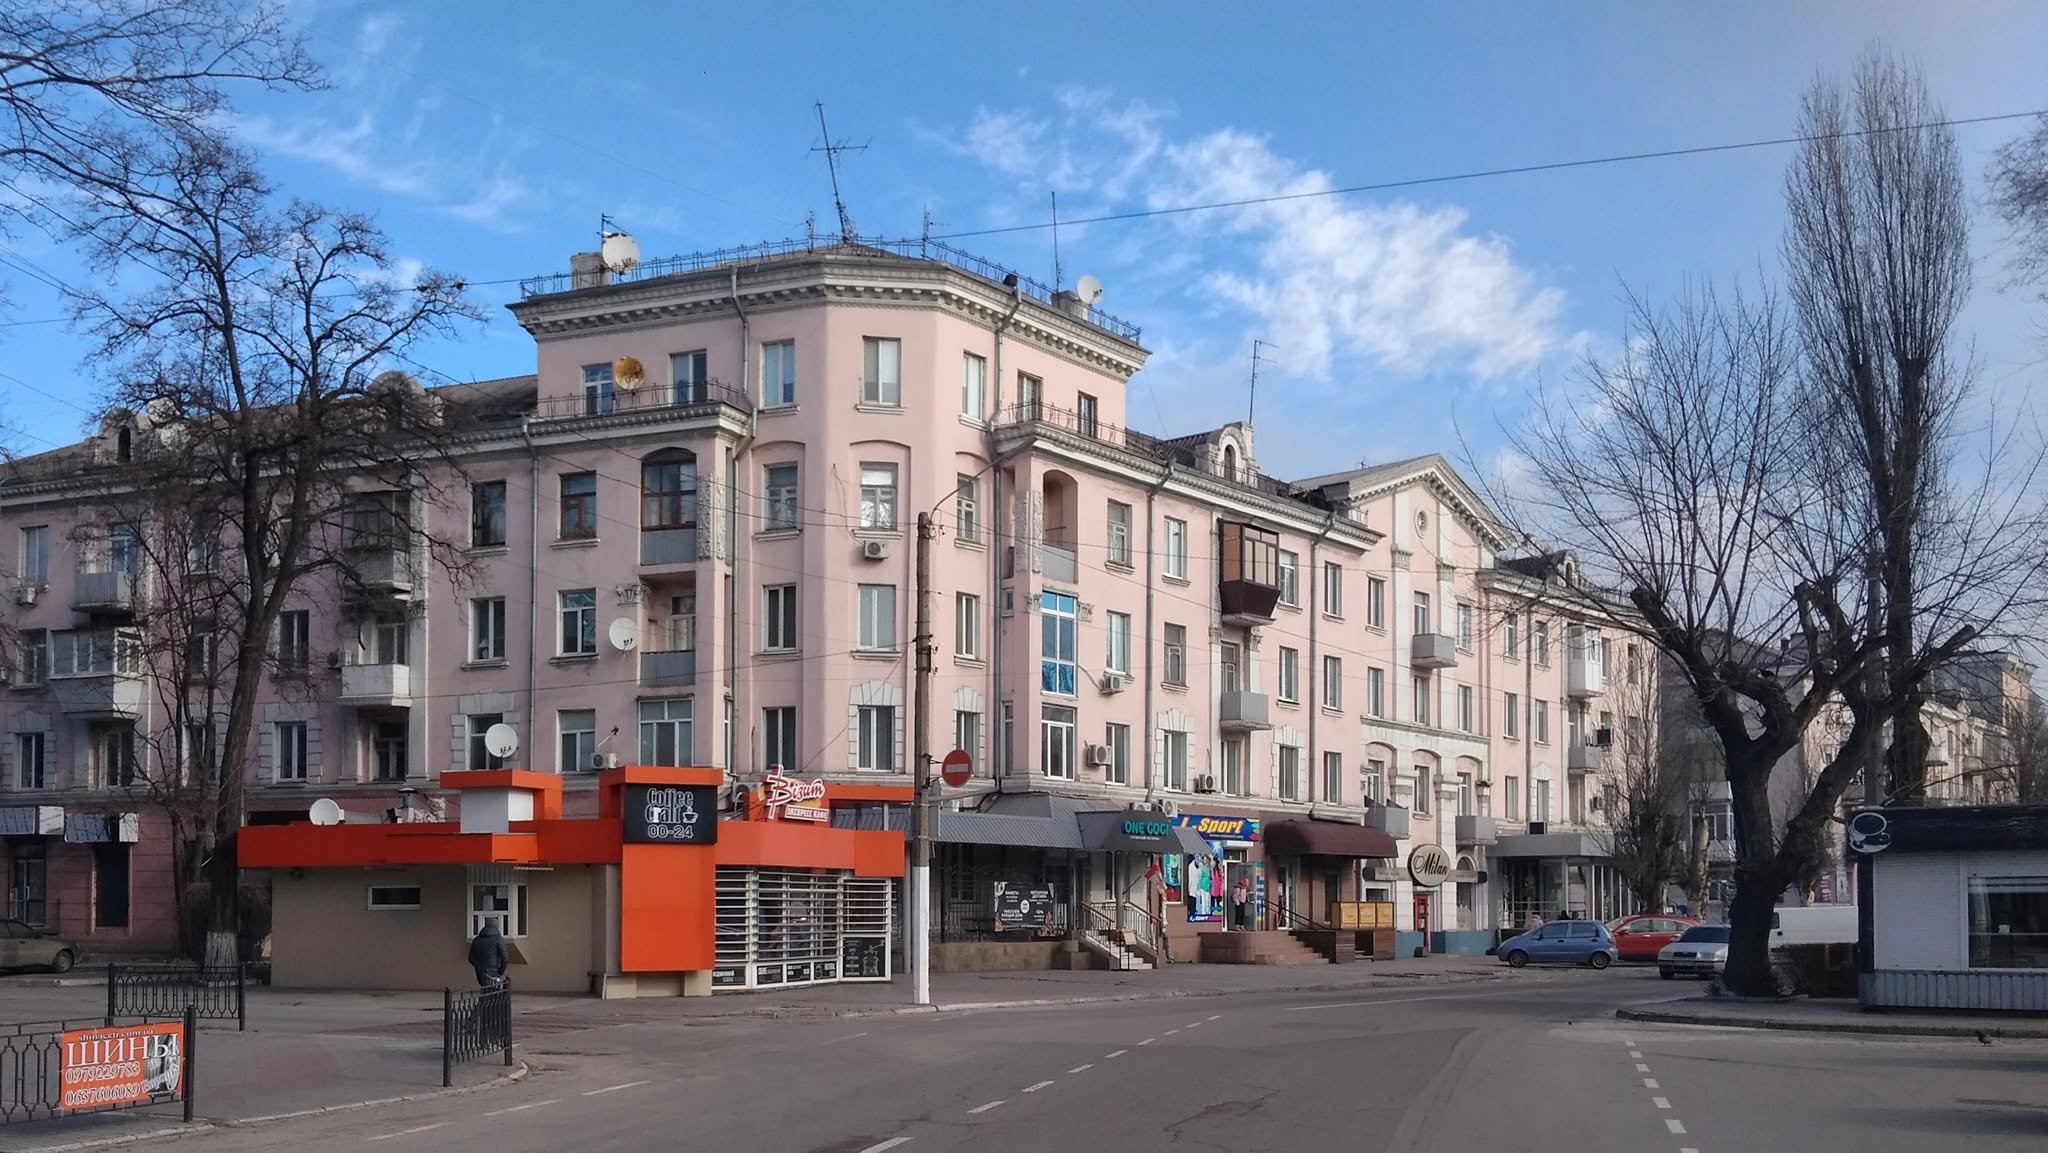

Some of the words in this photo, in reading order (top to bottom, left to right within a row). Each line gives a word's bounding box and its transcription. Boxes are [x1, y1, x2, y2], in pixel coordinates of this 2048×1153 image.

[647, 788, 694, 807] Coffee
[645, 804, 681, 823] Craft
[648, 824, 694, 838] 00-24
[1125, 820, 1145, 834] ONE
[1147, 821, 1169, 835] GOGI
[1413, 853, 1448, 875] Milan
[66, 1033, 178, 1068] ШИНЫ
[65, 1060, 141, 1085] 0979229783
[65, 1082, 141, 1106] 0637606089
